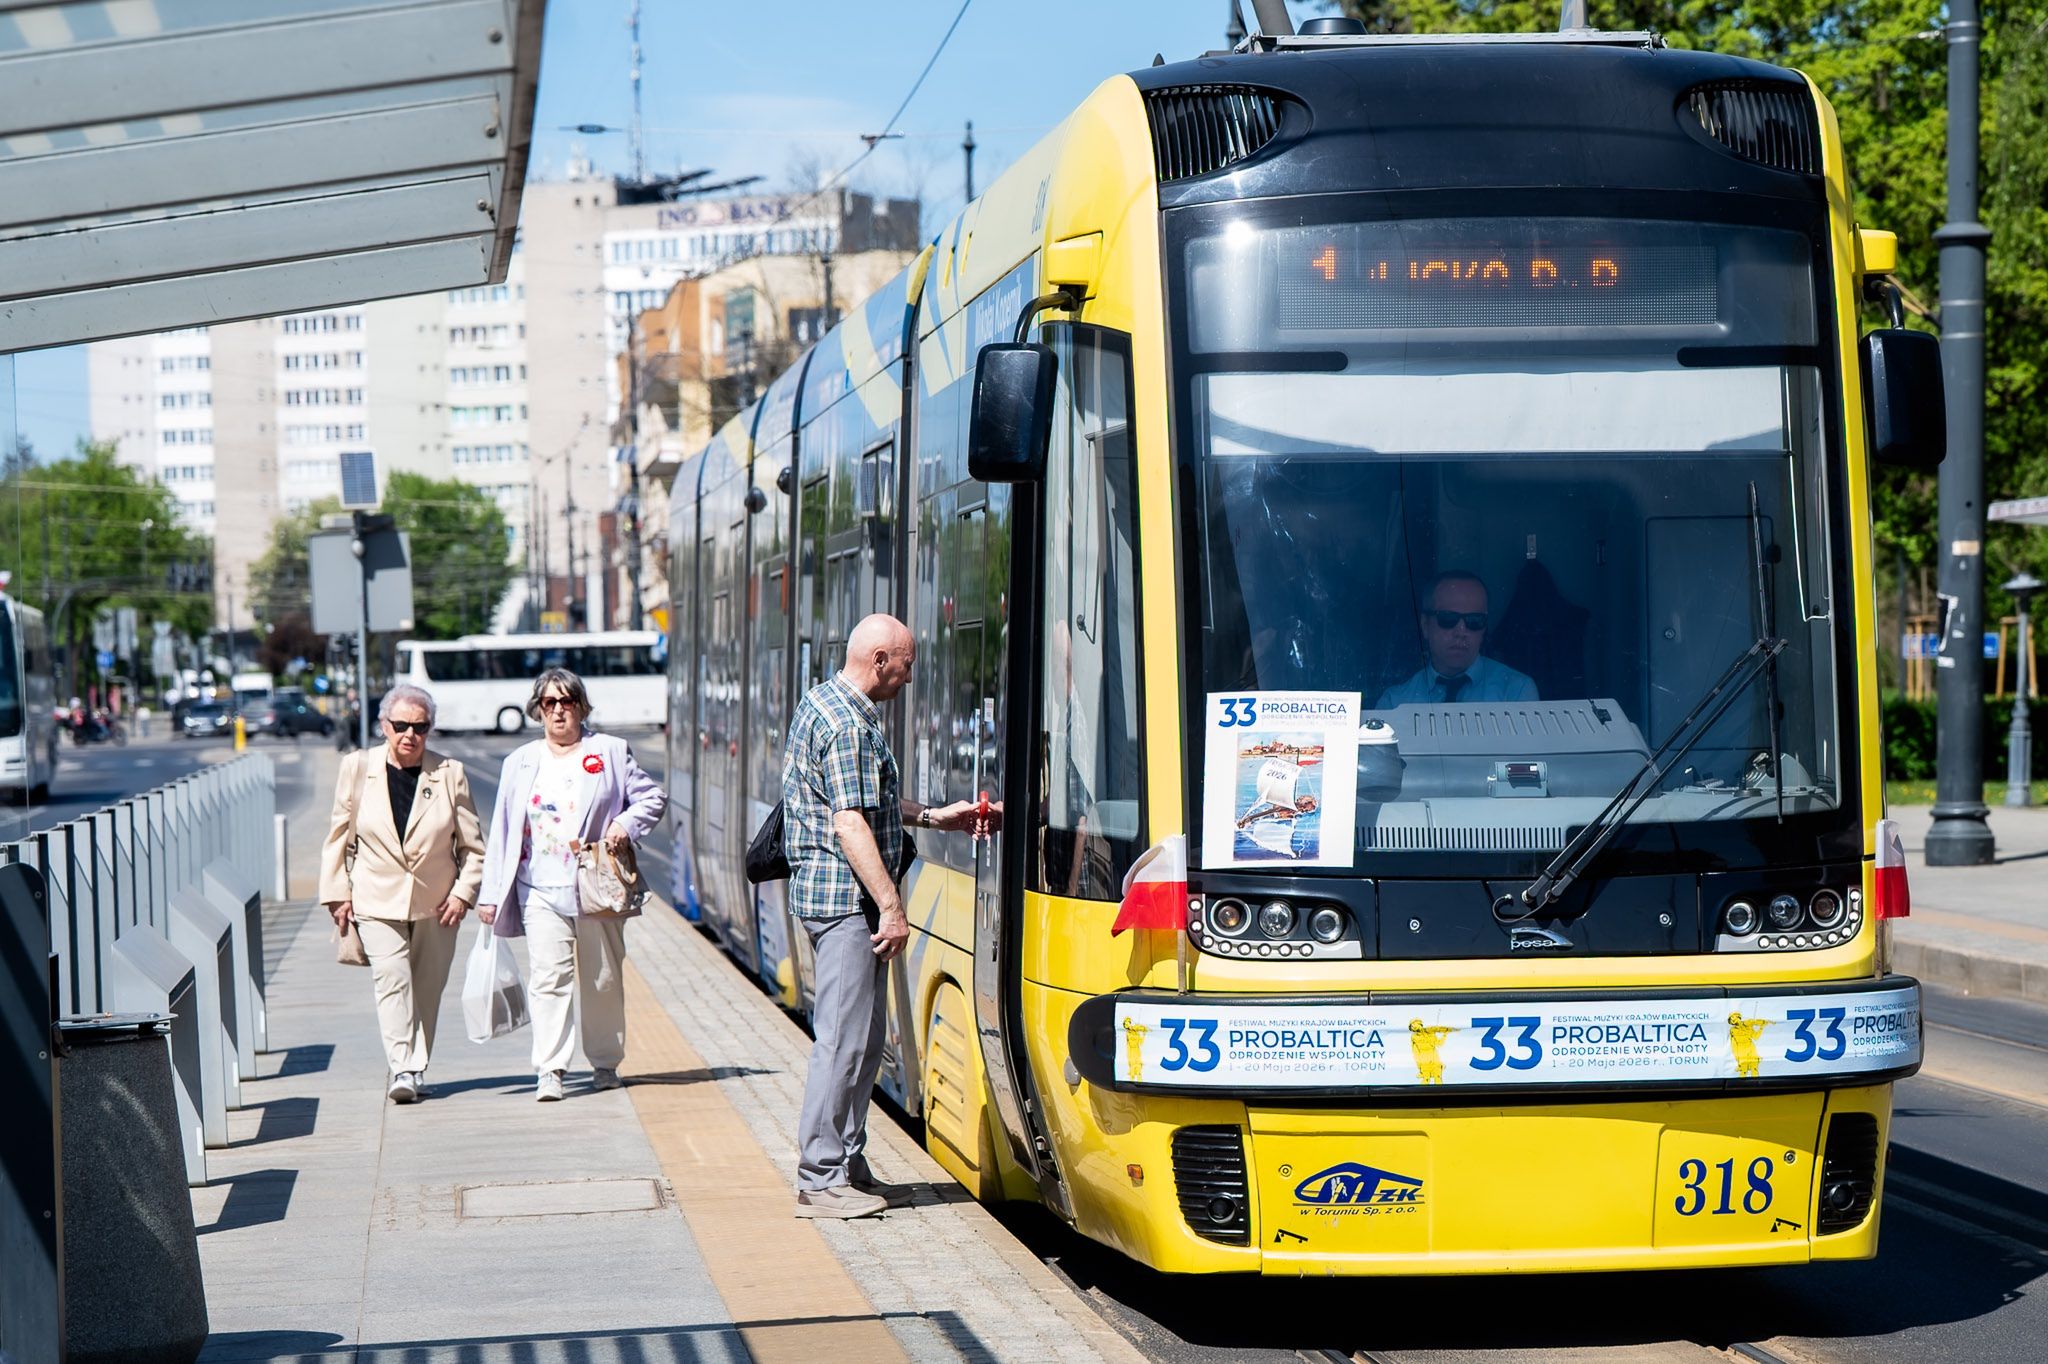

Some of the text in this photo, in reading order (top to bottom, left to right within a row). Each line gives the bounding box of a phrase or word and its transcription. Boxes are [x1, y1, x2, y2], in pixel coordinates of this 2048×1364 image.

[1218, 697, 1257, 728] 33
[1261, 703, 1347, 713] PROBALTICA
[1269, 1019, 1299, 1027] MUZYKI
[1552, 1015, 1592, 1023] FESTIWAL
[1594, 1014, 1623, 1022] MUZYKI
[1229, 1030, 1384, 1049] PROBALTICA
[1552, 1023, 1707, 1044] PROBALTICA
[1784, 1007, 1846, 1062] 33
[1160, 1018, 1220, 1072] 33
[1469, 1016, 1542, 1071] 33
[1552, 1043, 1708, 1056] ODRODZENIE WSPÓLNOTY
[1229, 1049, 1386, 1060] ODRODZENIE WSPÓLNOTY
[1244, 1063, 1260, 1072] 20
[1263, 1063, 1291, 1074] Maja
[1293, 1062, 1326, 1072] 2026
[1569, 1059, 1584, 1068] 20
[1588, 1058, 1615, 1069] Maja
[1618, 1057, 1650, 1067] 2026
[1674, 1156, 1774, 1216] 318
[1300, 1208, 1311, 1216] w
[1314, 1207, 1360, 1216] Toruniu
[1362, 1207, 1381, 1217] Sp.
[1396, 1206, 1417, 1214] o.o.
